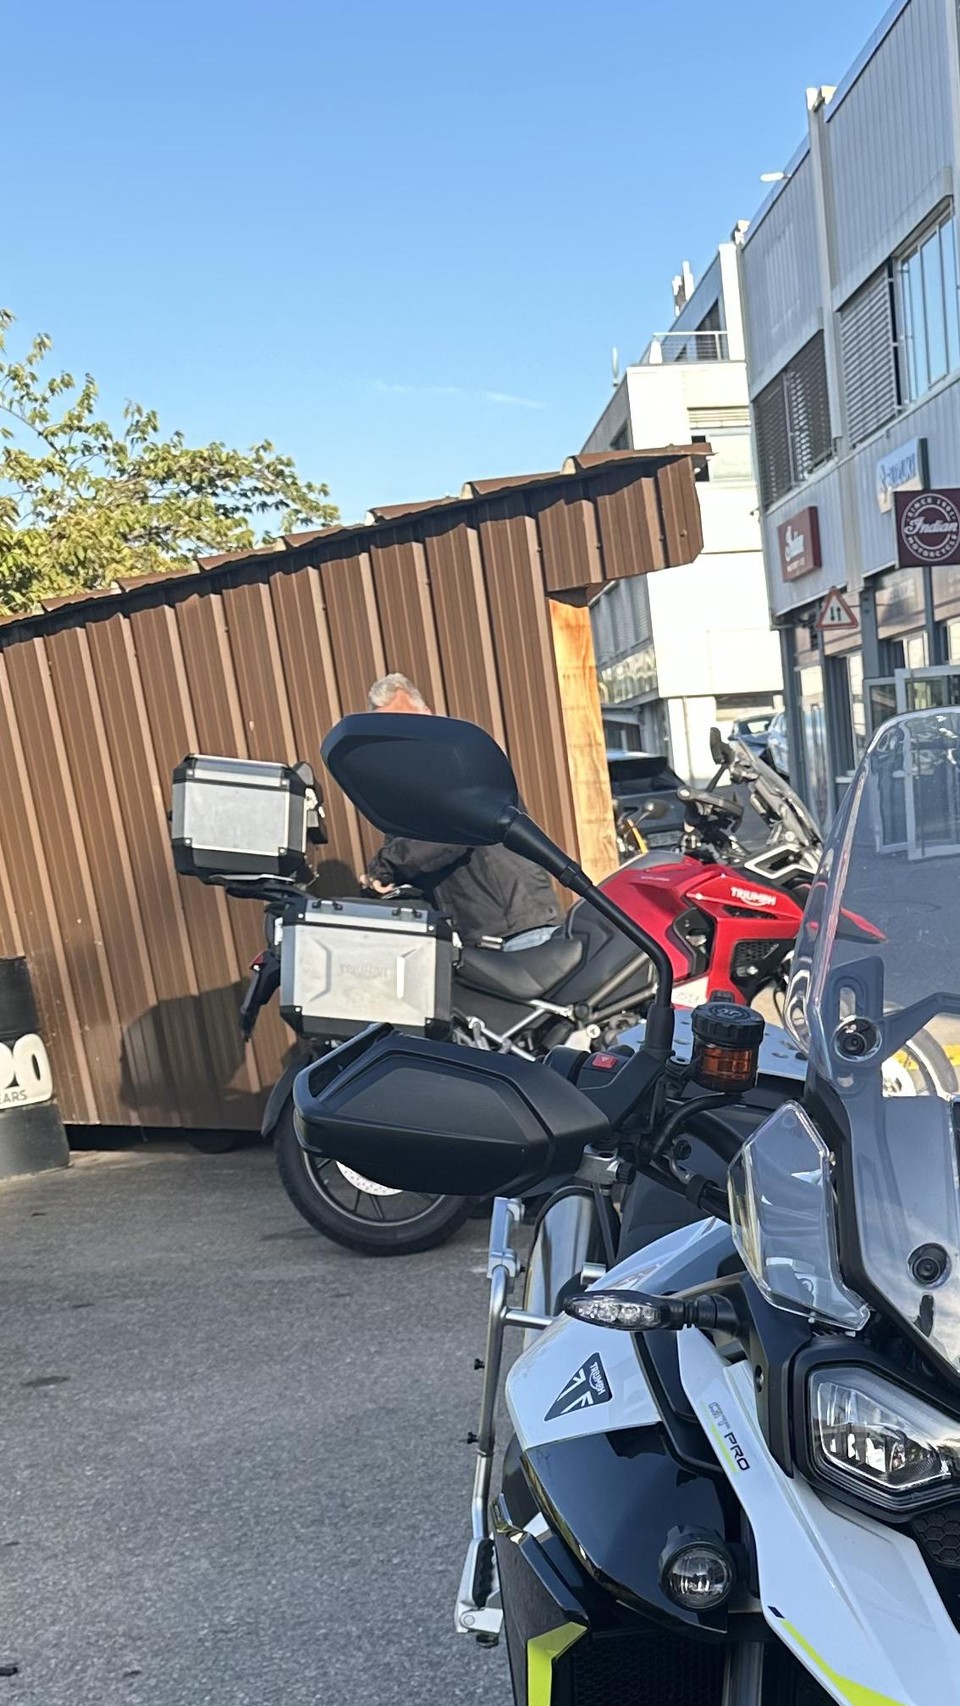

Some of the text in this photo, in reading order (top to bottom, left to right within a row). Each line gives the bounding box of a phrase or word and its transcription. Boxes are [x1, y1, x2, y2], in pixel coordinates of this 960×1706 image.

[904, 516, 958, 535] Indian
[731, 886, 777, 907] TRIUMPH
[0, 1089, 28, 1104] ARS
[589, 1361, 606, 1395] TRIUMPH
[708, 1401, 750, 1471] GT PRO
